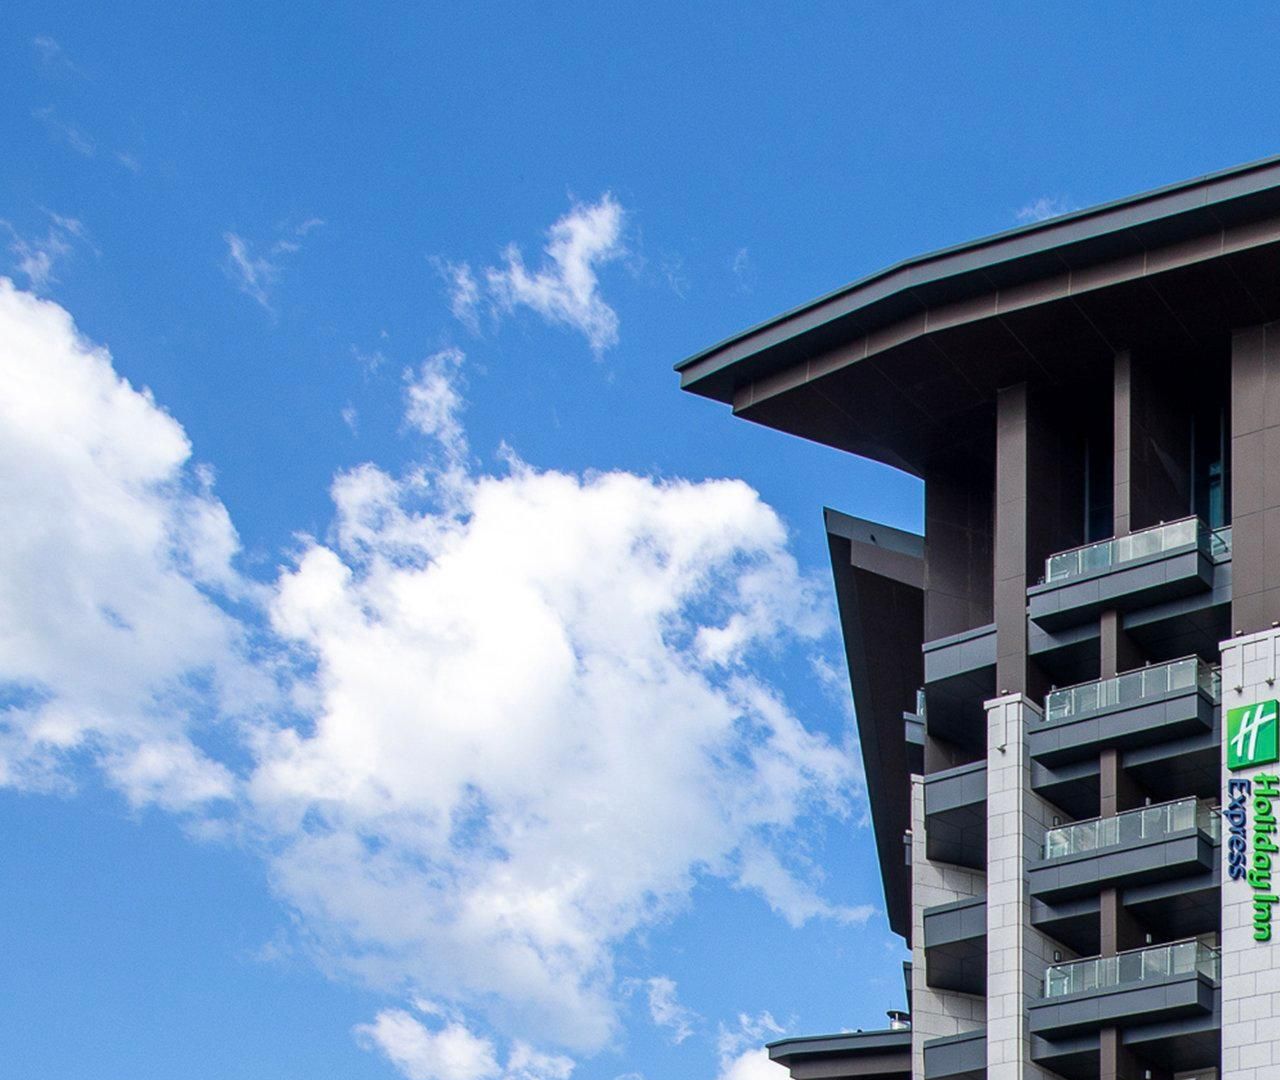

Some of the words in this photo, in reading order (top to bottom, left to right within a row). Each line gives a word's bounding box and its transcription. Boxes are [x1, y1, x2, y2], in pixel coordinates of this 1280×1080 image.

[1223, 778, 1252, 882] Express
[1249, 772, 1280, 890] Holiday
[1253, 893, 1280, 942] Inn
